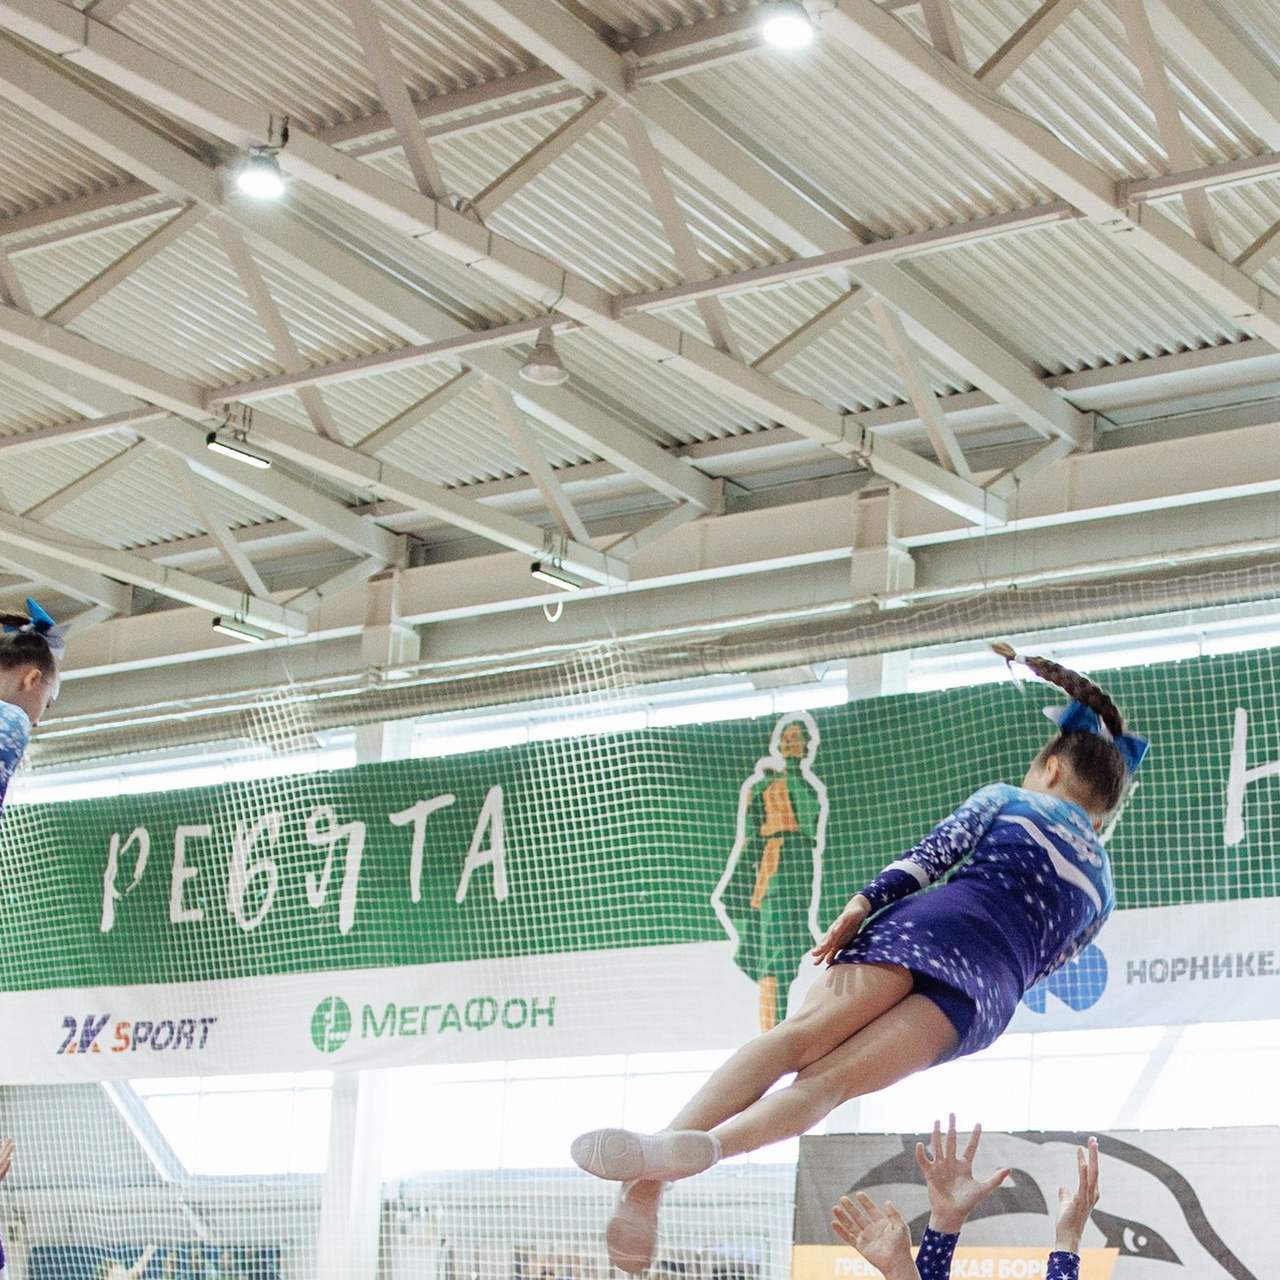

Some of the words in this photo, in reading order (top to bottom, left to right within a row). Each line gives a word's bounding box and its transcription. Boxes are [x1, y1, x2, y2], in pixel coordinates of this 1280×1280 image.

[101, 785, 509, 935] РЕБЯТА
[57, 1013, 110, 1055] 2K
[111, 1017, 217, 1052] SPORT
[361, 996, 556, 1039] МЕГАФОН
